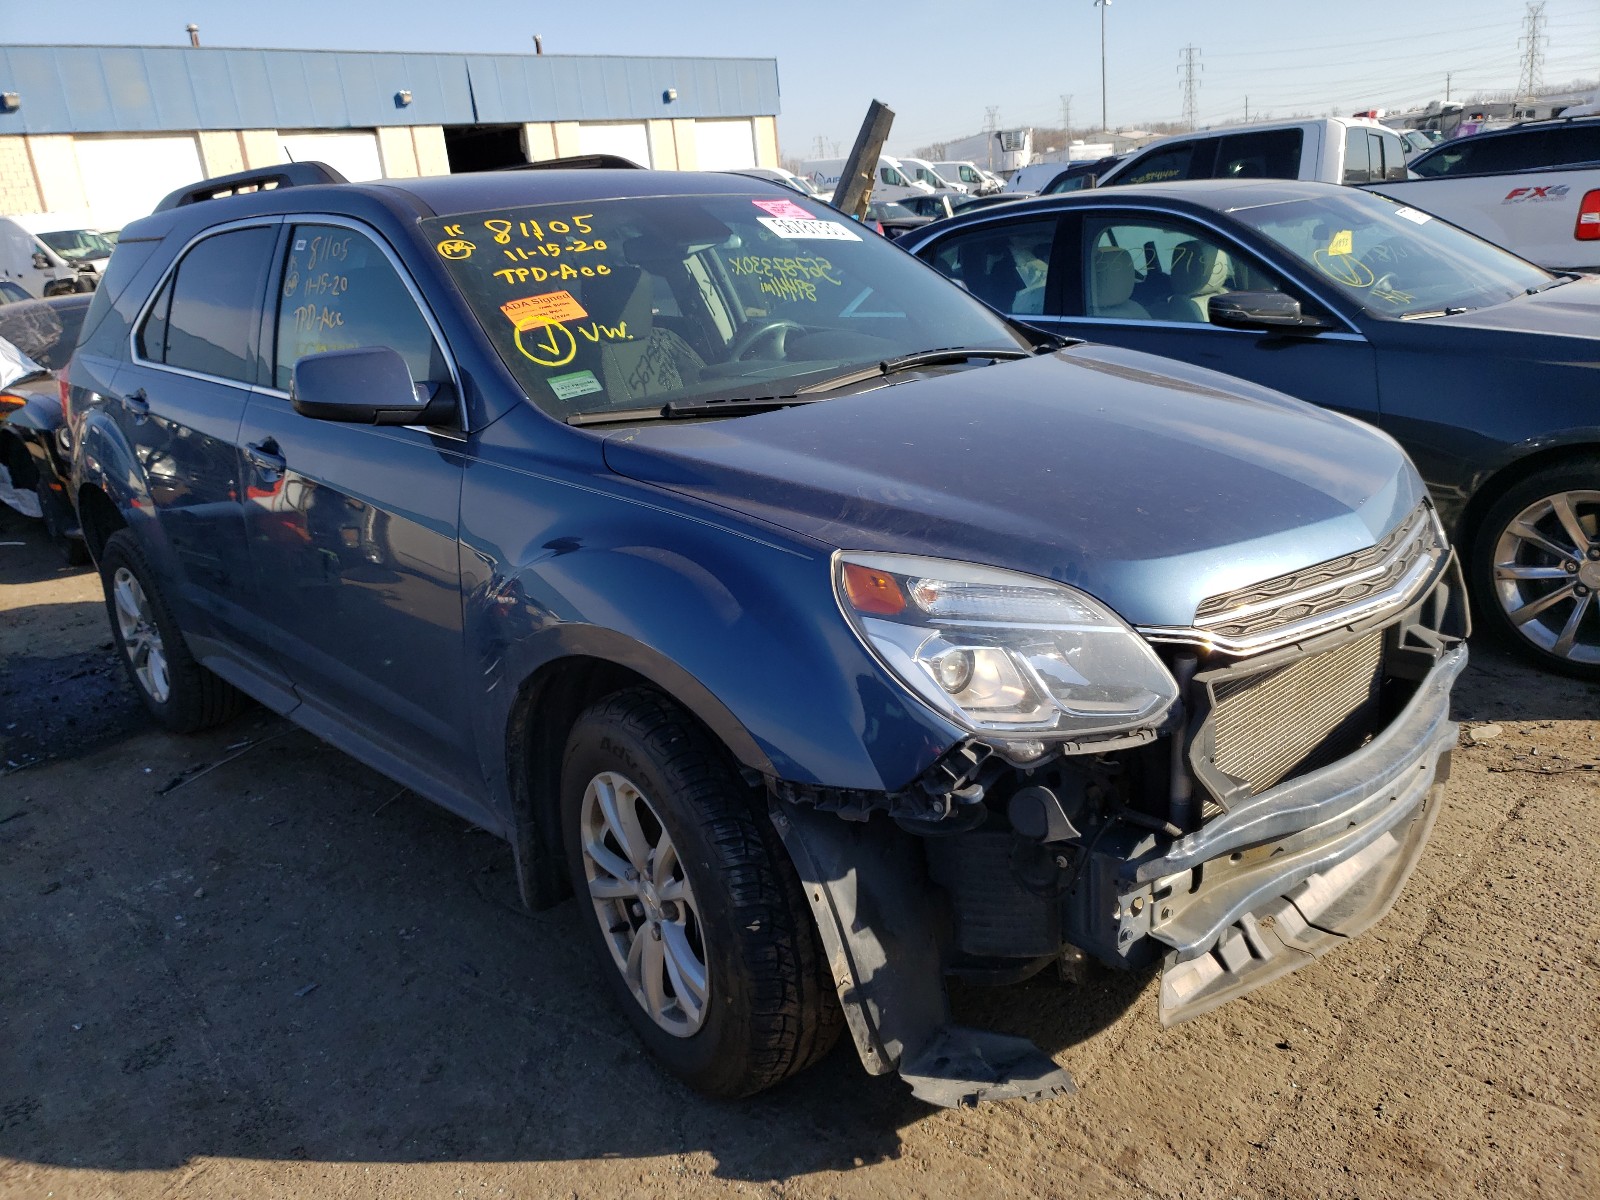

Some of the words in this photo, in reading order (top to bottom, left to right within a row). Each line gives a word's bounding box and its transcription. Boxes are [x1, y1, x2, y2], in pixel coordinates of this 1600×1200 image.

[1505, 184, 1571, 199] FX4
[504, 301, 531, 312] ADA
[531, 292, 571, 305] Signed
